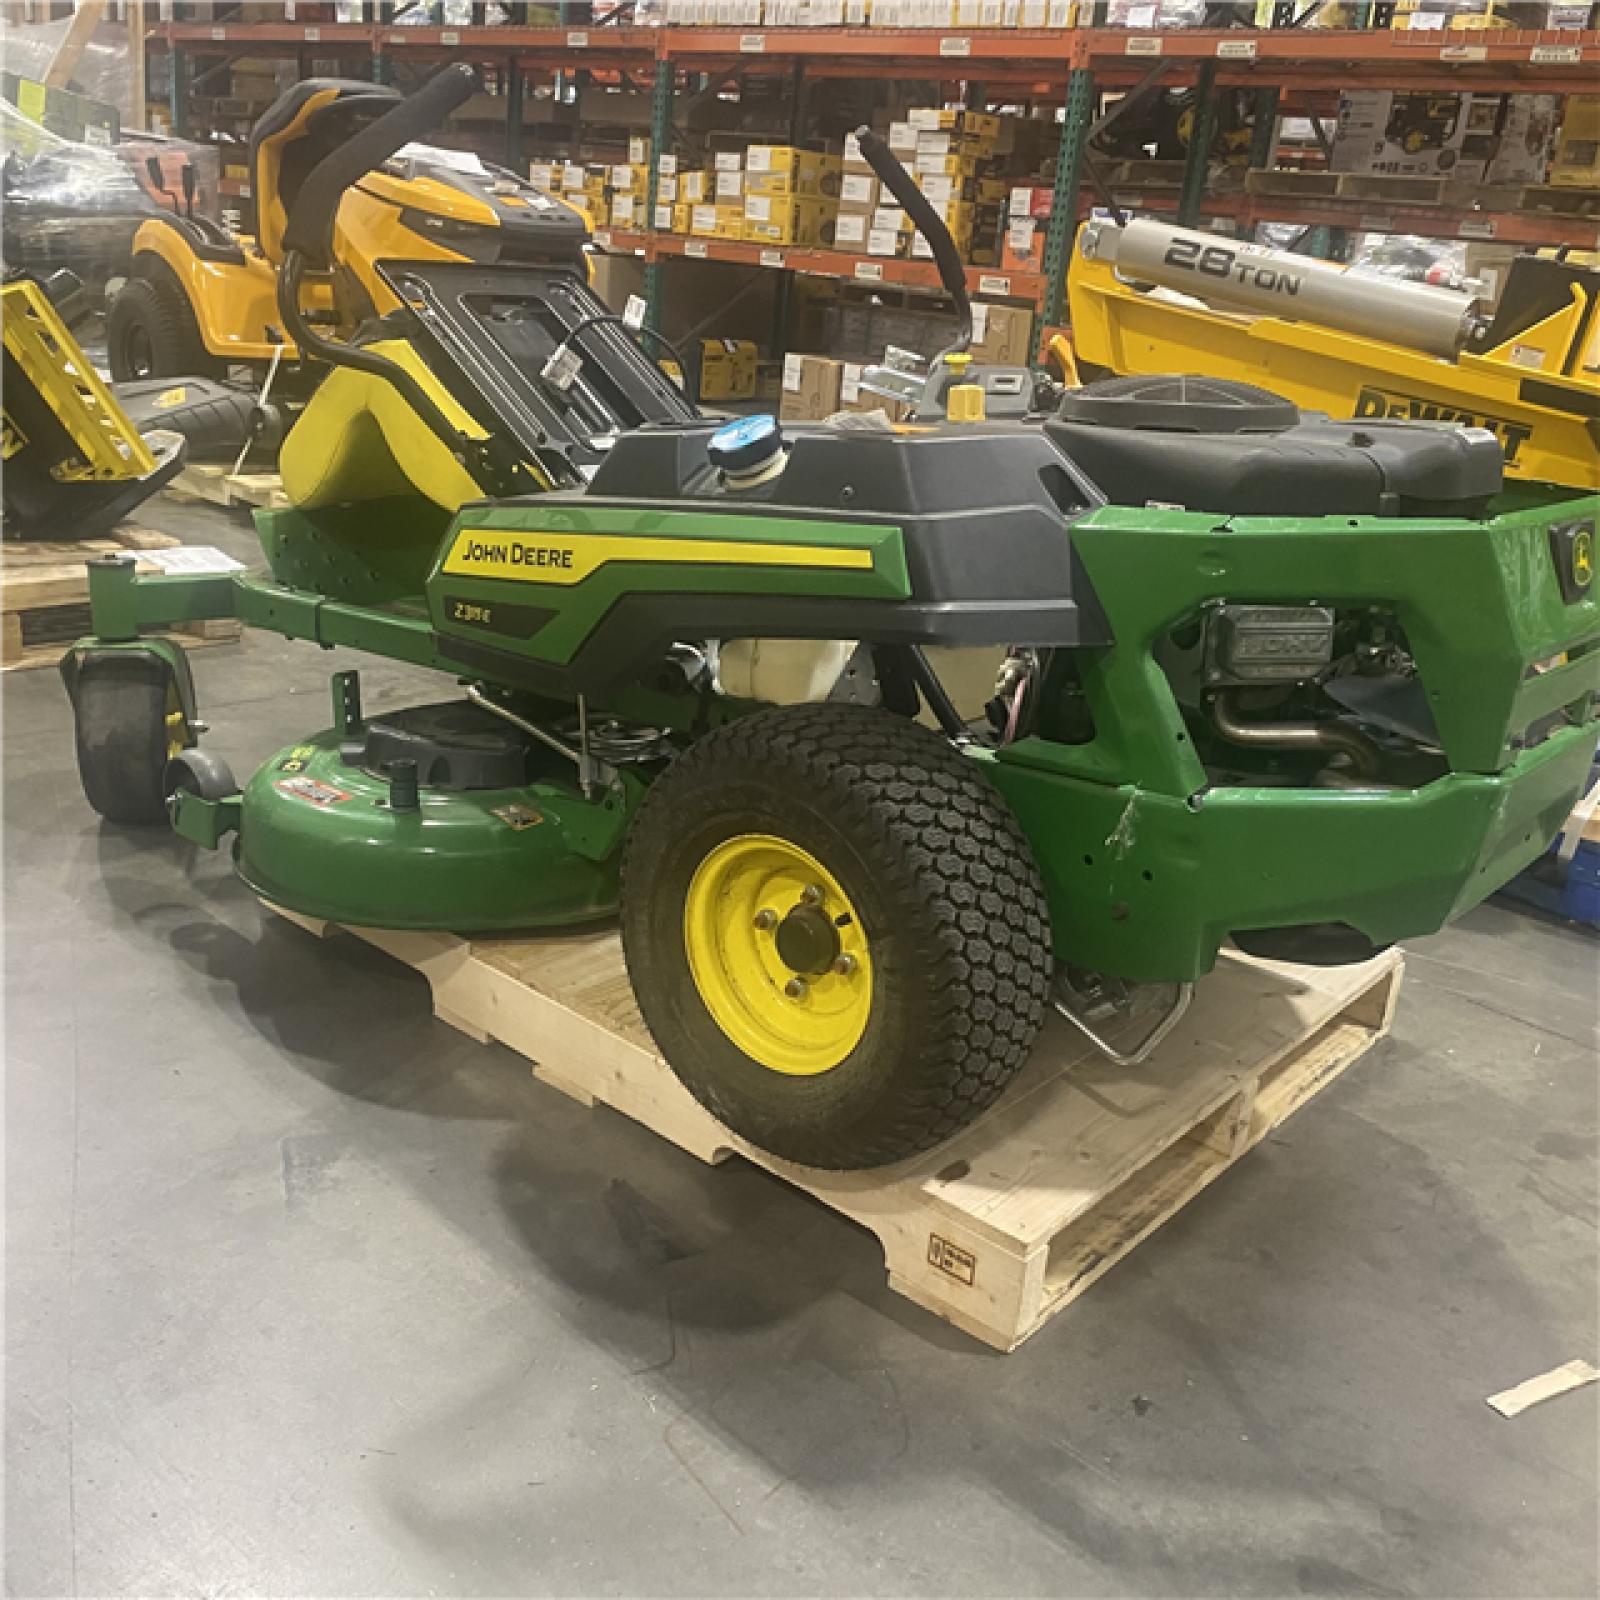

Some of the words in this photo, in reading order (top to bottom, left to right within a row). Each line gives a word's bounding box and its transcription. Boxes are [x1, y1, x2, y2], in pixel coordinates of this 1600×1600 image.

[1164, 237, 1235, 278] 28
[1234, 262, 1302, 296] TON
[462, 540, 508, 563] JOHN
[510, 542, 573, 568] DEERE
